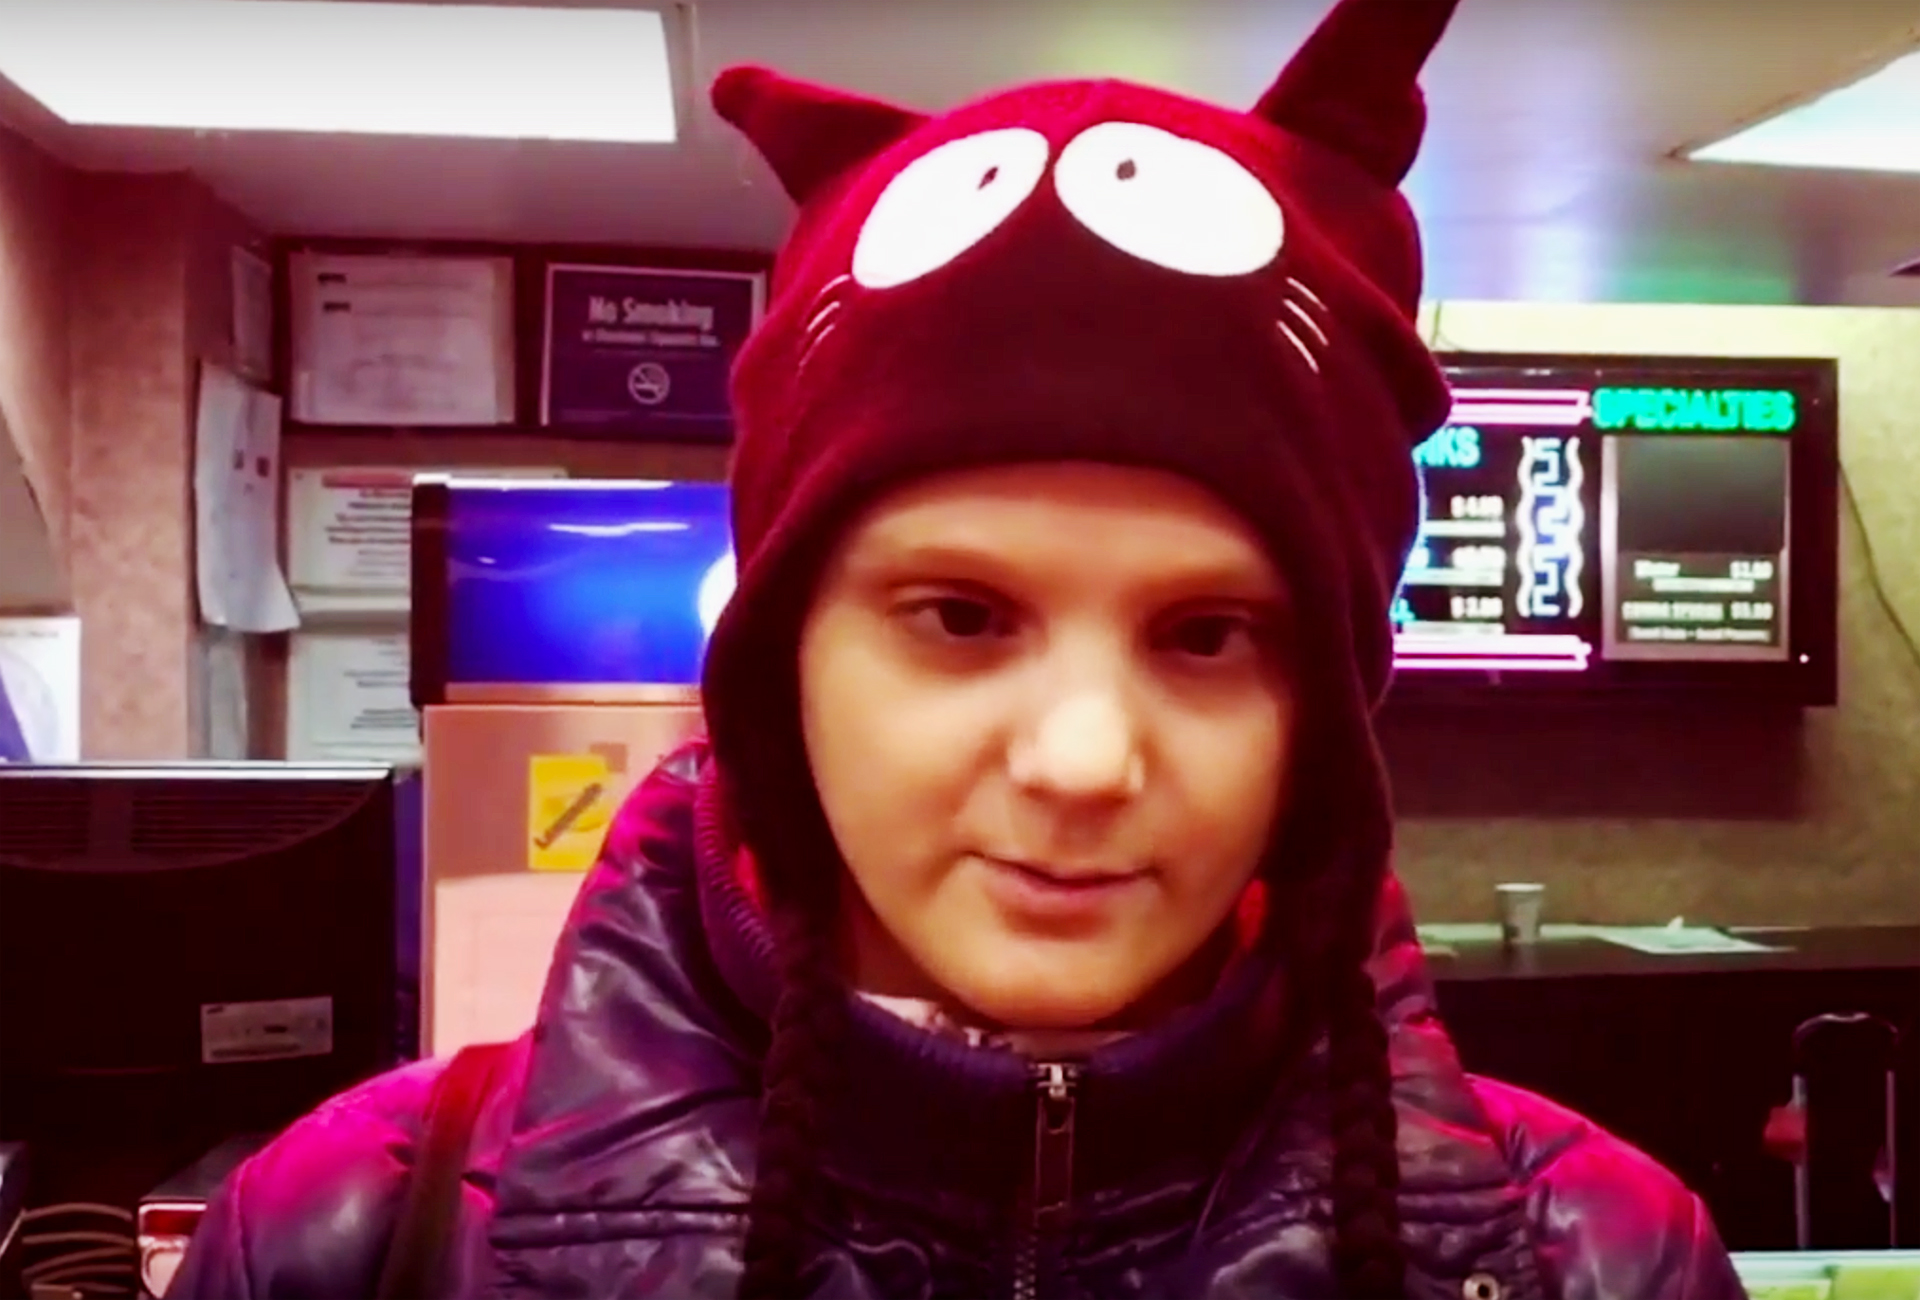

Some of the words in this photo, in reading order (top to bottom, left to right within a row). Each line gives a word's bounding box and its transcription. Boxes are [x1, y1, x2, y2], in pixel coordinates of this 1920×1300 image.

[589, 296, 617, 323] No
[623, 297, 714, 331] Smoking
[1592, 387, 1796, 430] SPECIALTIES
